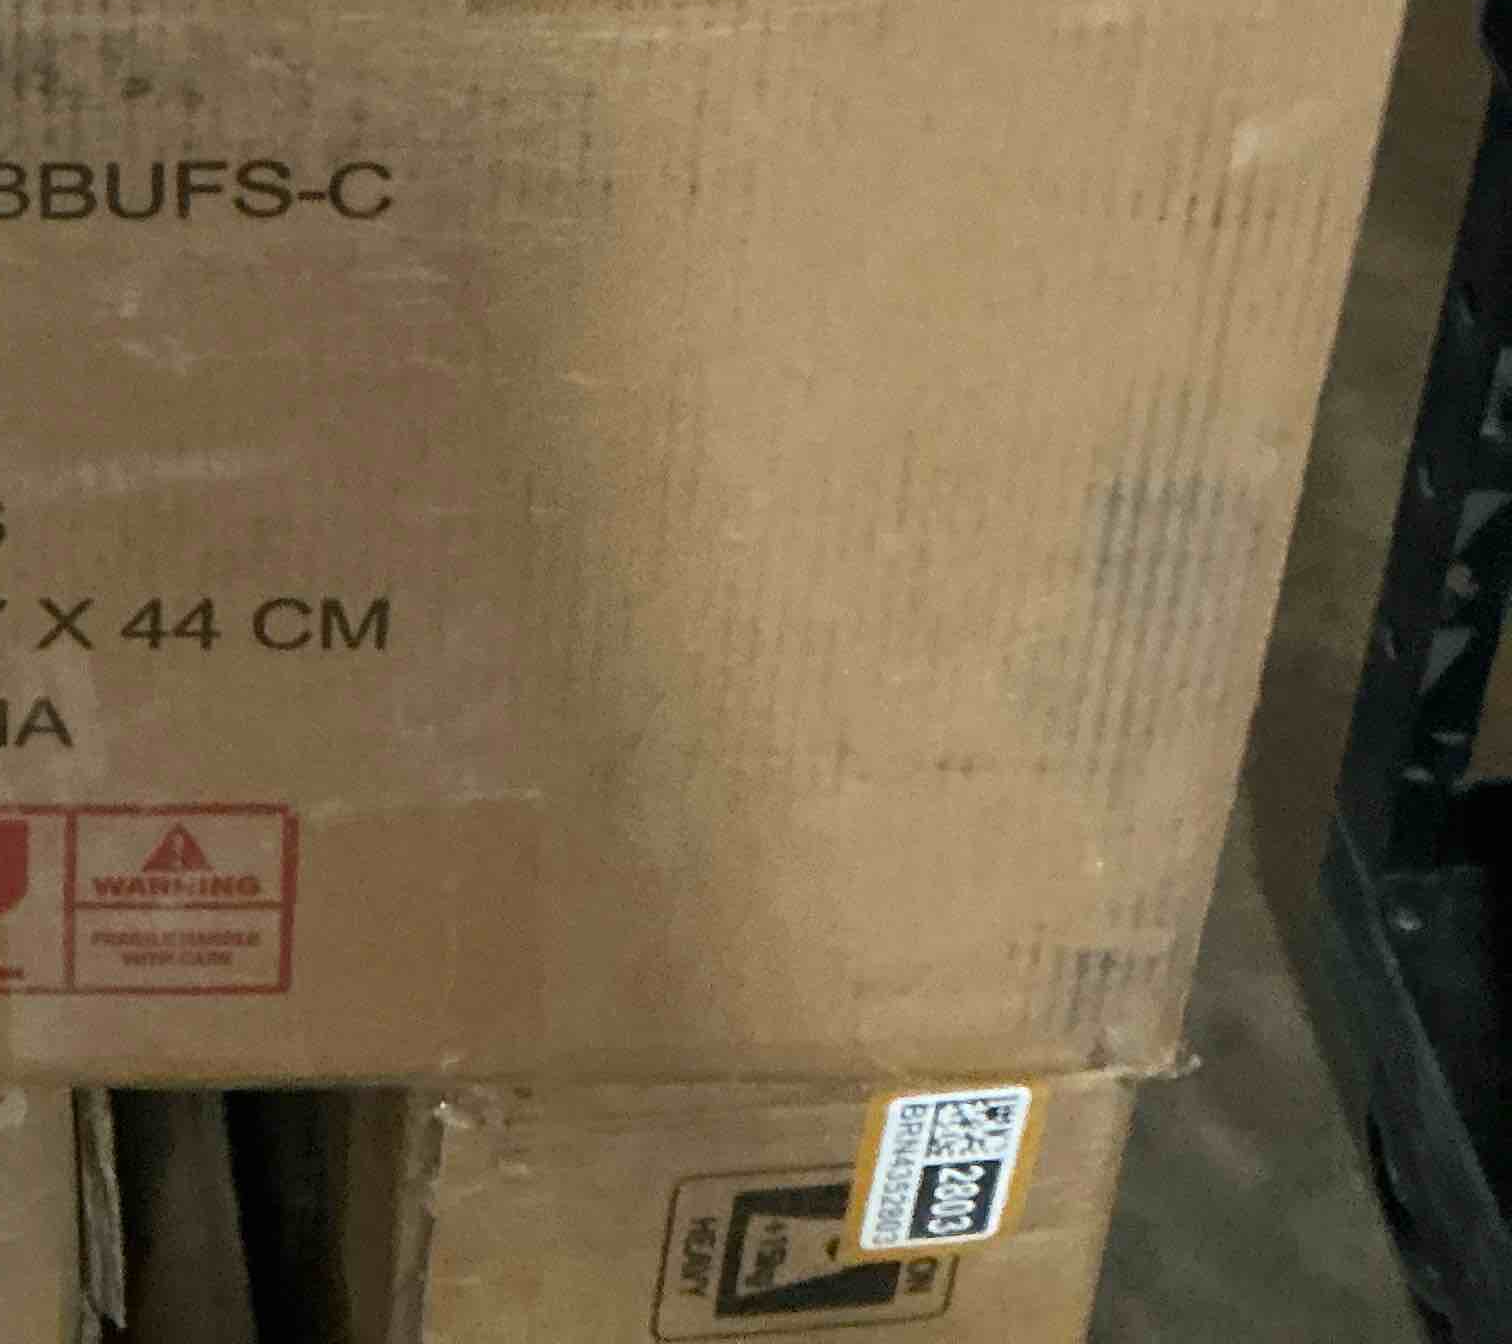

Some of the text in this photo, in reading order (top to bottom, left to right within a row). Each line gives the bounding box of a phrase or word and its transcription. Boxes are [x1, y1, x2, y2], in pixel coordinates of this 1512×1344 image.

[36, 598, 95, 650] X
[120, 598, 221, 650] 44
[252, 598, 391, 651] CM
[92, 875, 261, 897] WARNING
[928, 1164, 986, 1234] 2803
